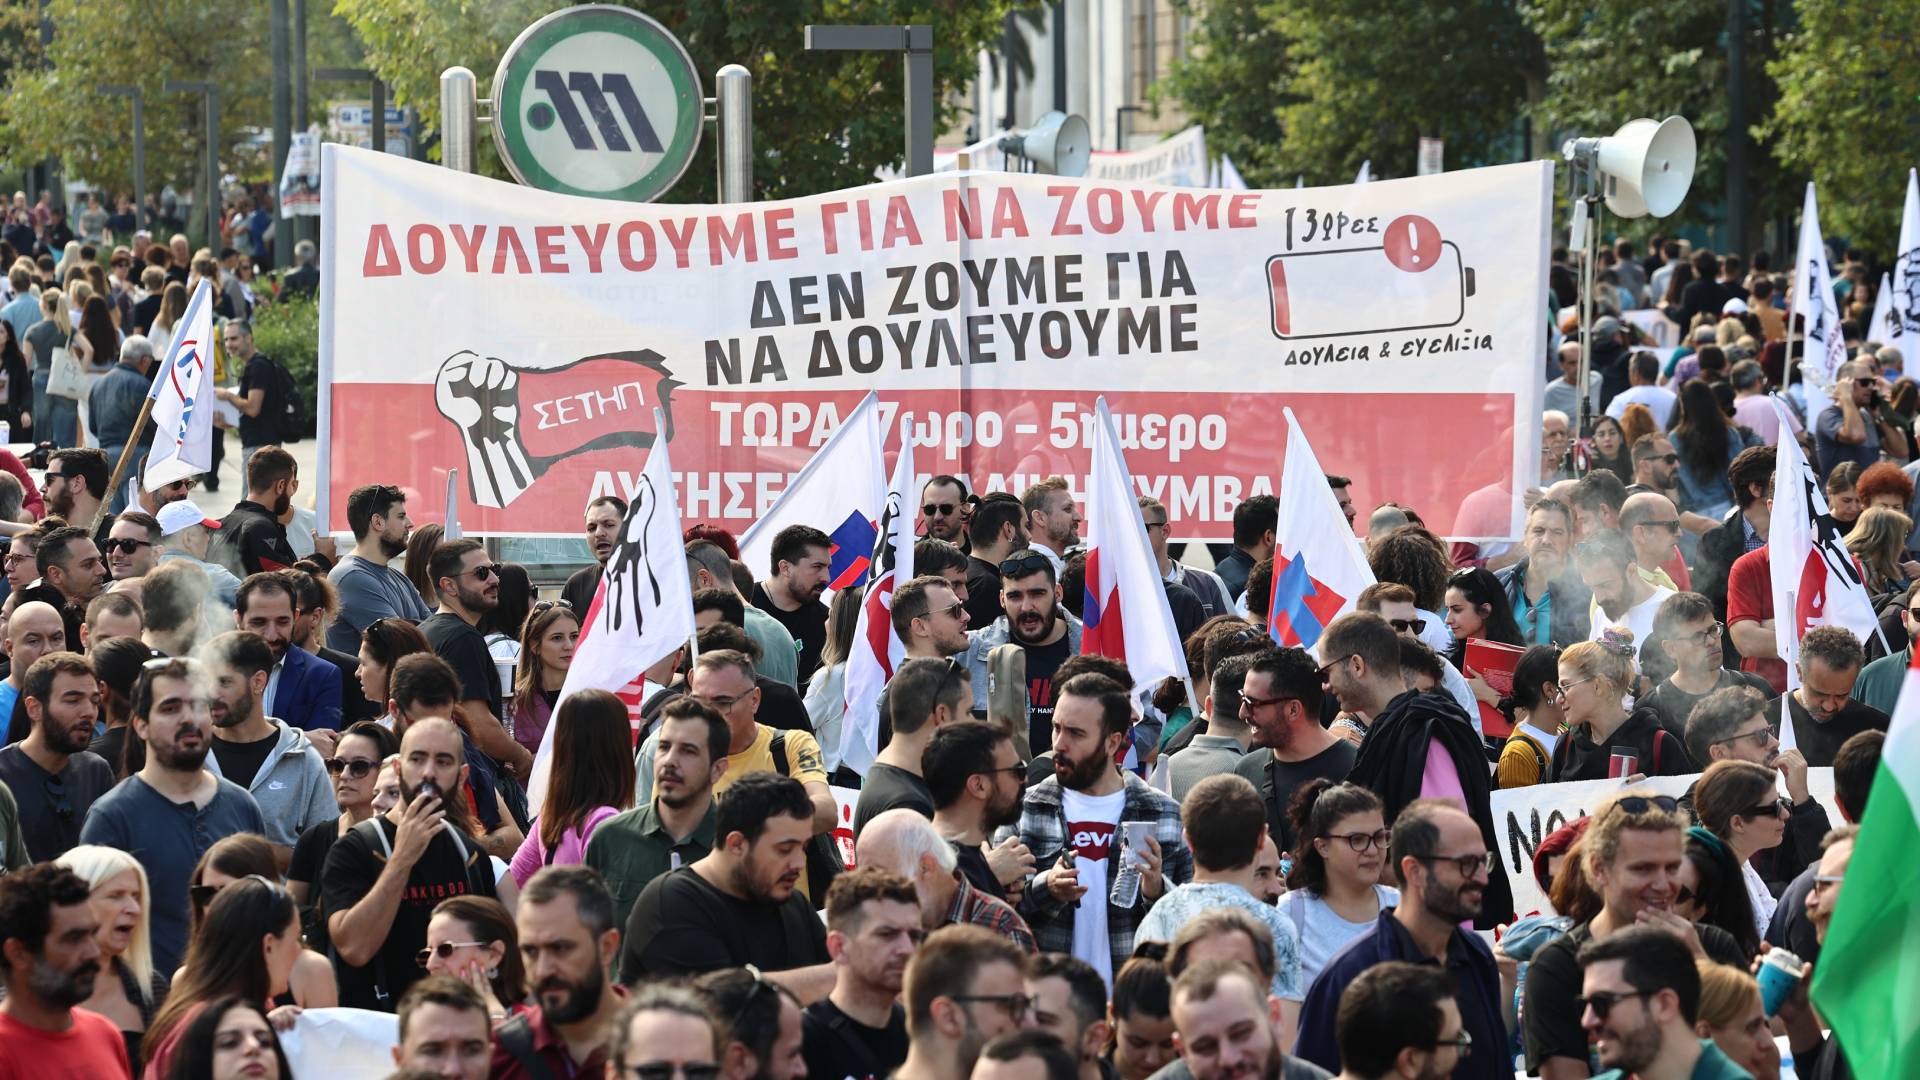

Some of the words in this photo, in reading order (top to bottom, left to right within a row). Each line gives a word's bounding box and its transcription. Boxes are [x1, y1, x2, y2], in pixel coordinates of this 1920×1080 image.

[363, 208, 799, 278] ΔΟΥΛΕΥΟΥΜΕ
[821, 195, 923, 255] ΓΙΑ
[943, 187, 1029, 241] ΝΑ
[1047, 186, 1263, 236] ΖΟΥΜΕ
[750, 271, 865, 328] ΔΕΝ
[886, 254, 1084, 316] ΖΟΥΜΕ
[1106, 250, 1197, 300] ΓΙΑ
[705, 335, 788, 385] ΝΑ
[808, 304, 1199, 379] ΔΟΥΛΕΥΟΥΜΕ
[1379, 342, 1390, 358] &
[533, 381, 645, 430] ΣΕΤΗΠ
[710, 402, 845, 447] ΤΩΡΑ
